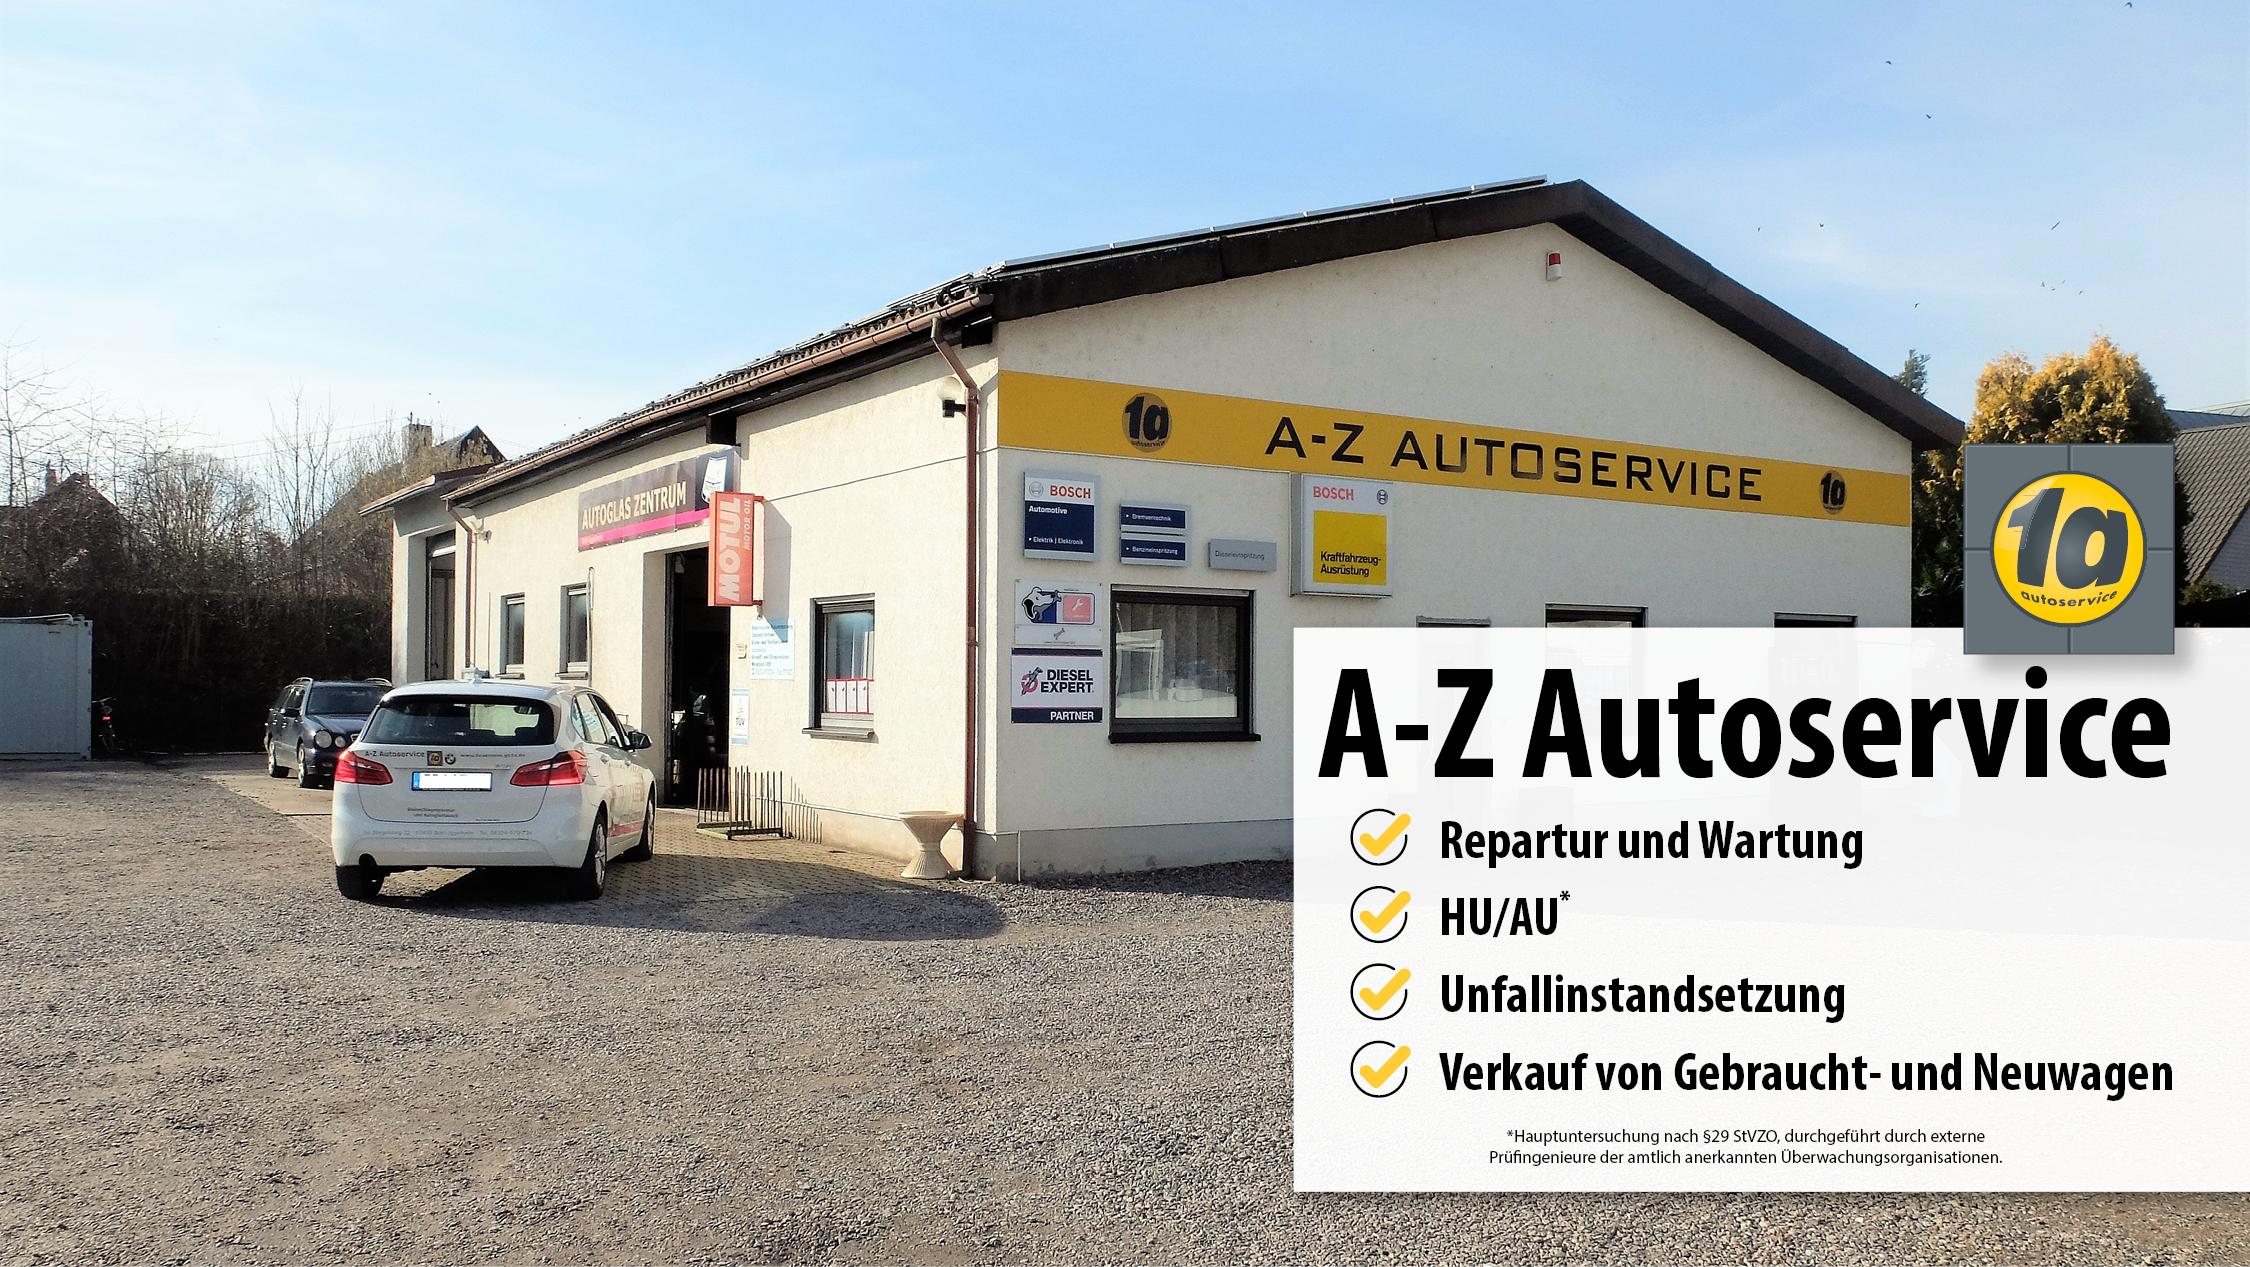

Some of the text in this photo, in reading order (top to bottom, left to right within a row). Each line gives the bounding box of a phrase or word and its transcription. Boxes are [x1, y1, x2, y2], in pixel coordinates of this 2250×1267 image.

[1265, 416, 1762, 502] A-Z AUTOSERVICE
[1050, 485, 1091, 499] BOSCH
[1313, 486, 1354, 500] BOSCH
[582, 496, 632, 529] AUTOGLAS
[633, 481, 686, 516] ZENTRUM
[1028, 505, 1068, 515] Automotive
[1033, 536, 1054, 544] Elektrik
[719, 497, 741, 602] MOTUL
[1320, 551, 1381, 566] Kraftfahrzeug-
[1320, 564, 1370, 577] Ausrüstung
[1047, 669, 1093, 681] DIESEL
[1040, 681, 1094, 693] EXPERT
[1050, 711, 1094, 721] PARTNER
